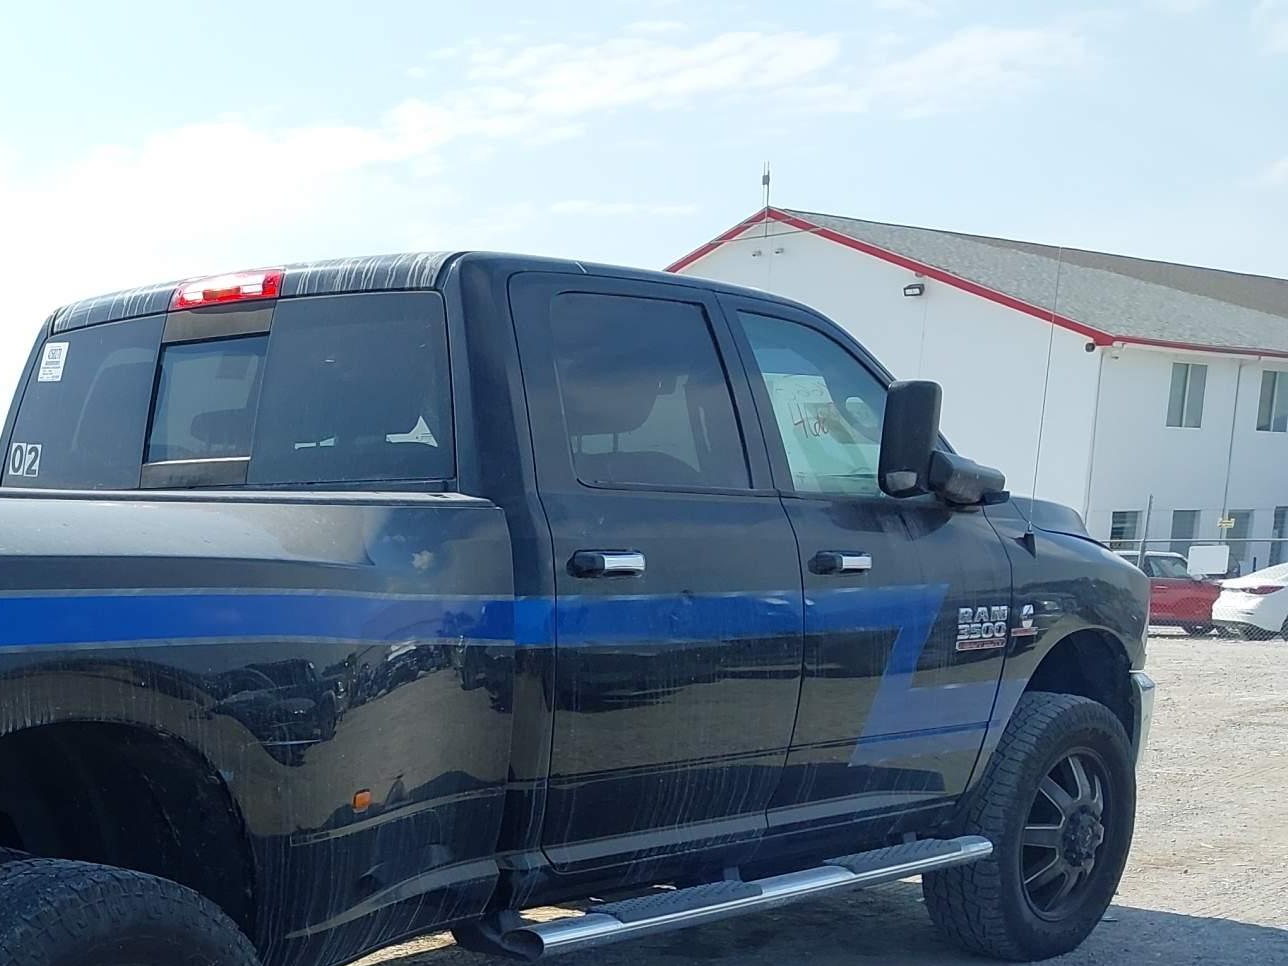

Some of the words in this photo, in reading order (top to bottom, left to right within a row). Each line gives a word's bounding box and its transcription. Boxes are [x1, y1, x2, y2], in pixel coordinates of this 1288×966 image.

[11, 444, 40, 475] 02
[957, 605, 1009, 623] RAM
[956, 621, 1007, 640] 3500
